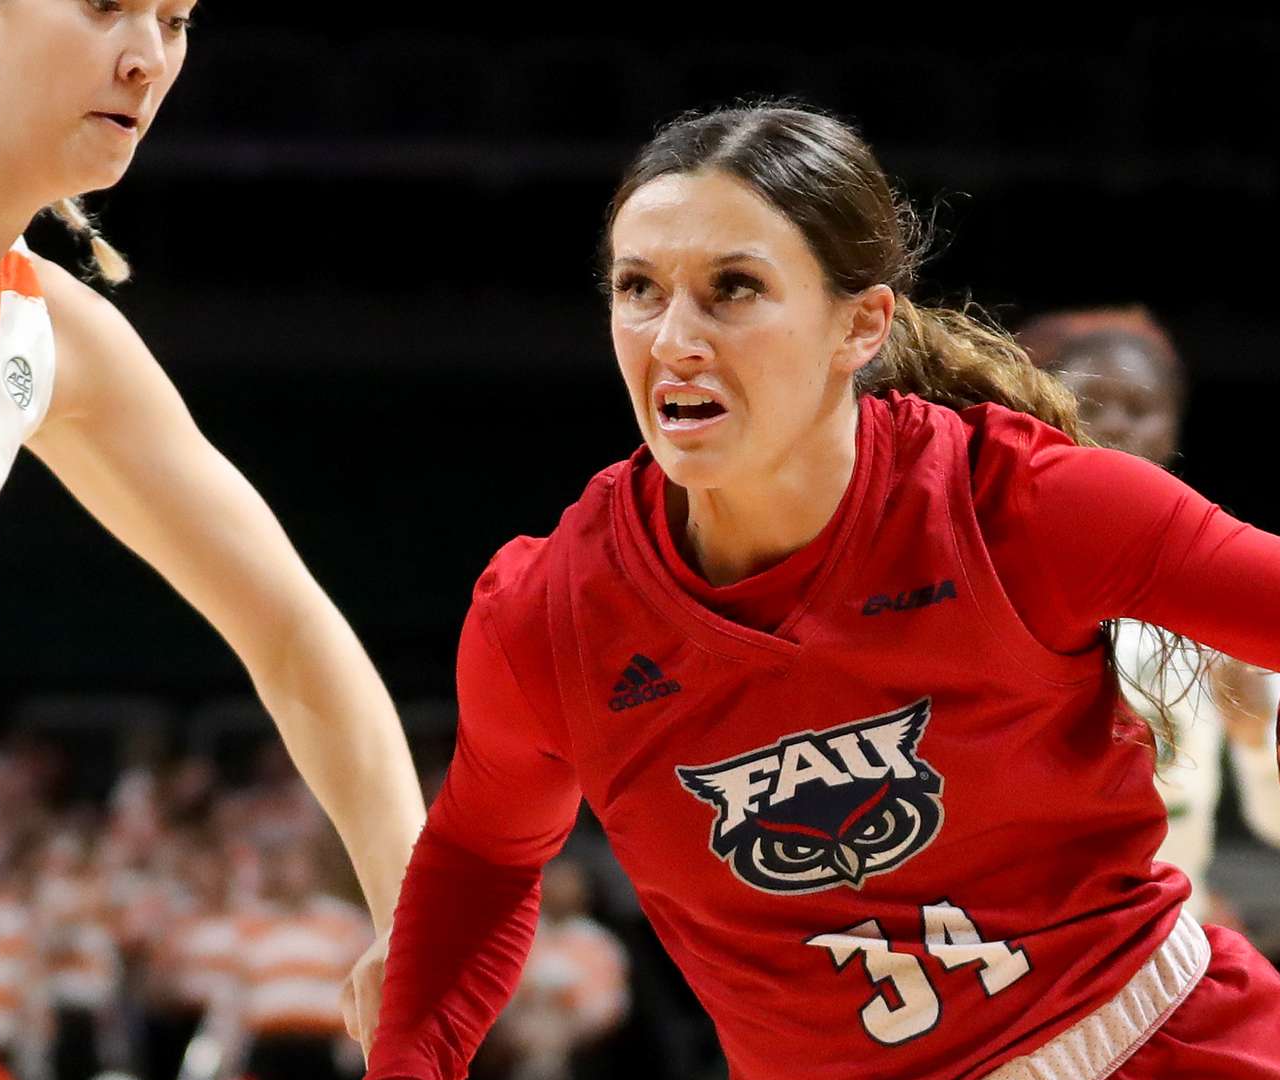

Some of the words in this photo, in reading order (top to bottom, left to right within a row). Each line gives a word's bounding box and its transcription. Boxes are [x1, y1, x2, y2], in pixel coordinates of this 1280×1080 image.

[608, 678, 681, 712] adidas
[695, 711, 918, 838] FAU
[803, 897, 1032, 1046] 34
